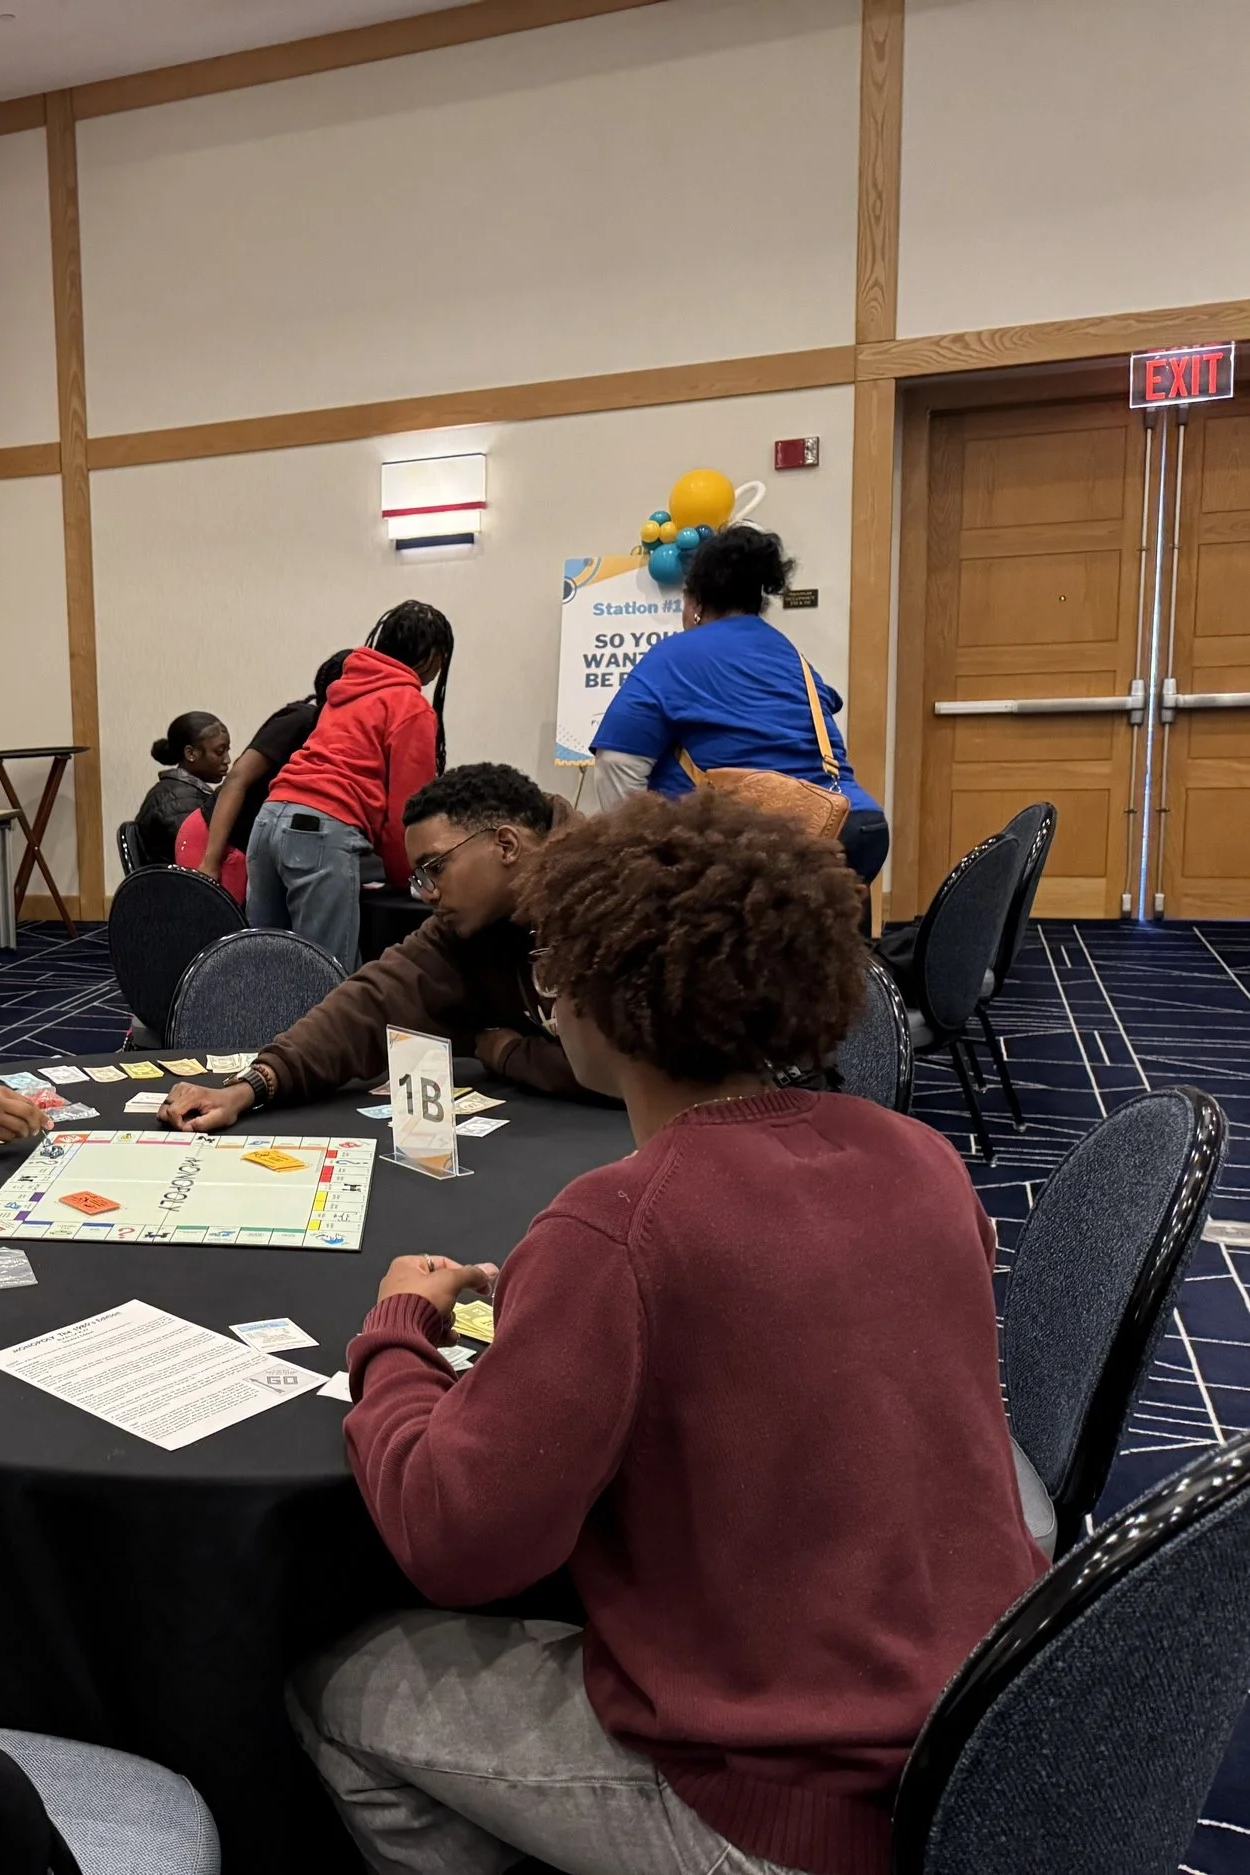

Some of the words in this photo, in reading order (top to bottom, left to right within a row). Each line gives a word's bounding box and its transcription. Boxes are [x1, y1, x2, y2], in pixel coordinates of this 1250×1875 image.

[1145, 352, 1224, 401] EXIT
[593, 601, 658, 616] Station
[662, 599, 682, 613] #1
[594, 633, 625, 649] SO
[585, 672, 613, 688] BE
[399, 1074, 444, 1123] 1B
[158, 1156, 204, 1212] MONOPOLY
[266, 1376, 298, 1385] GO
